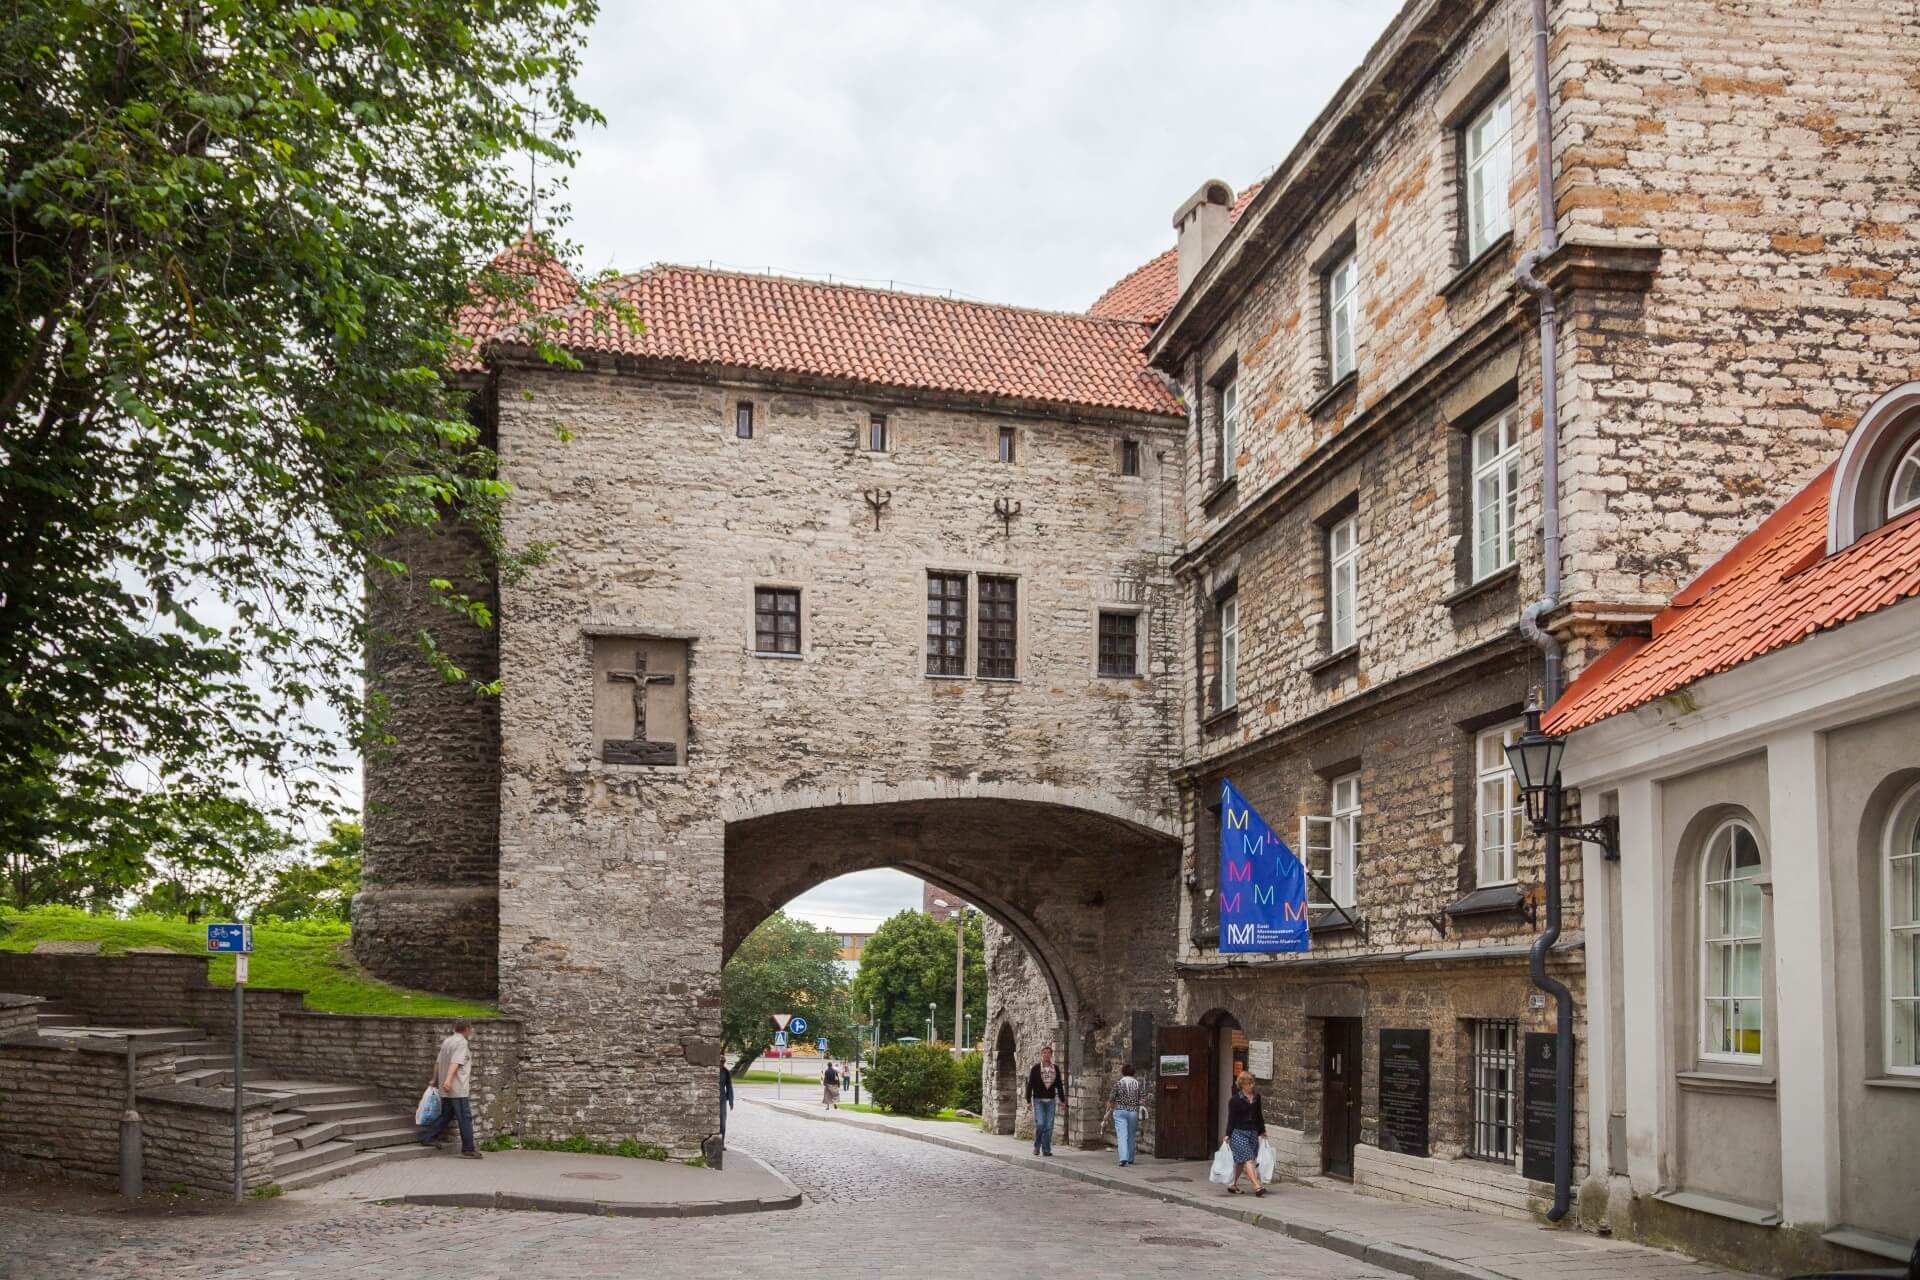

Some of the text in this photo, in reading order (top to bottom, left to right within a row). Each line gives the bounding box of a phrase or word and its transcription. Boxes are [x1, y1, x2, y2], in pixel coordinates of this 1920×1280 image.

[1228, 808, 1249, 830] M
[1243, 834, 1264, 856] M
[1229, 860, 1251, 882] M
[1276, 856, 1296, 878] M
[1220, 892, 1240, 913] M
[1254, 883, 1274, 905] M
[1284, 901, 1307, 922] M
